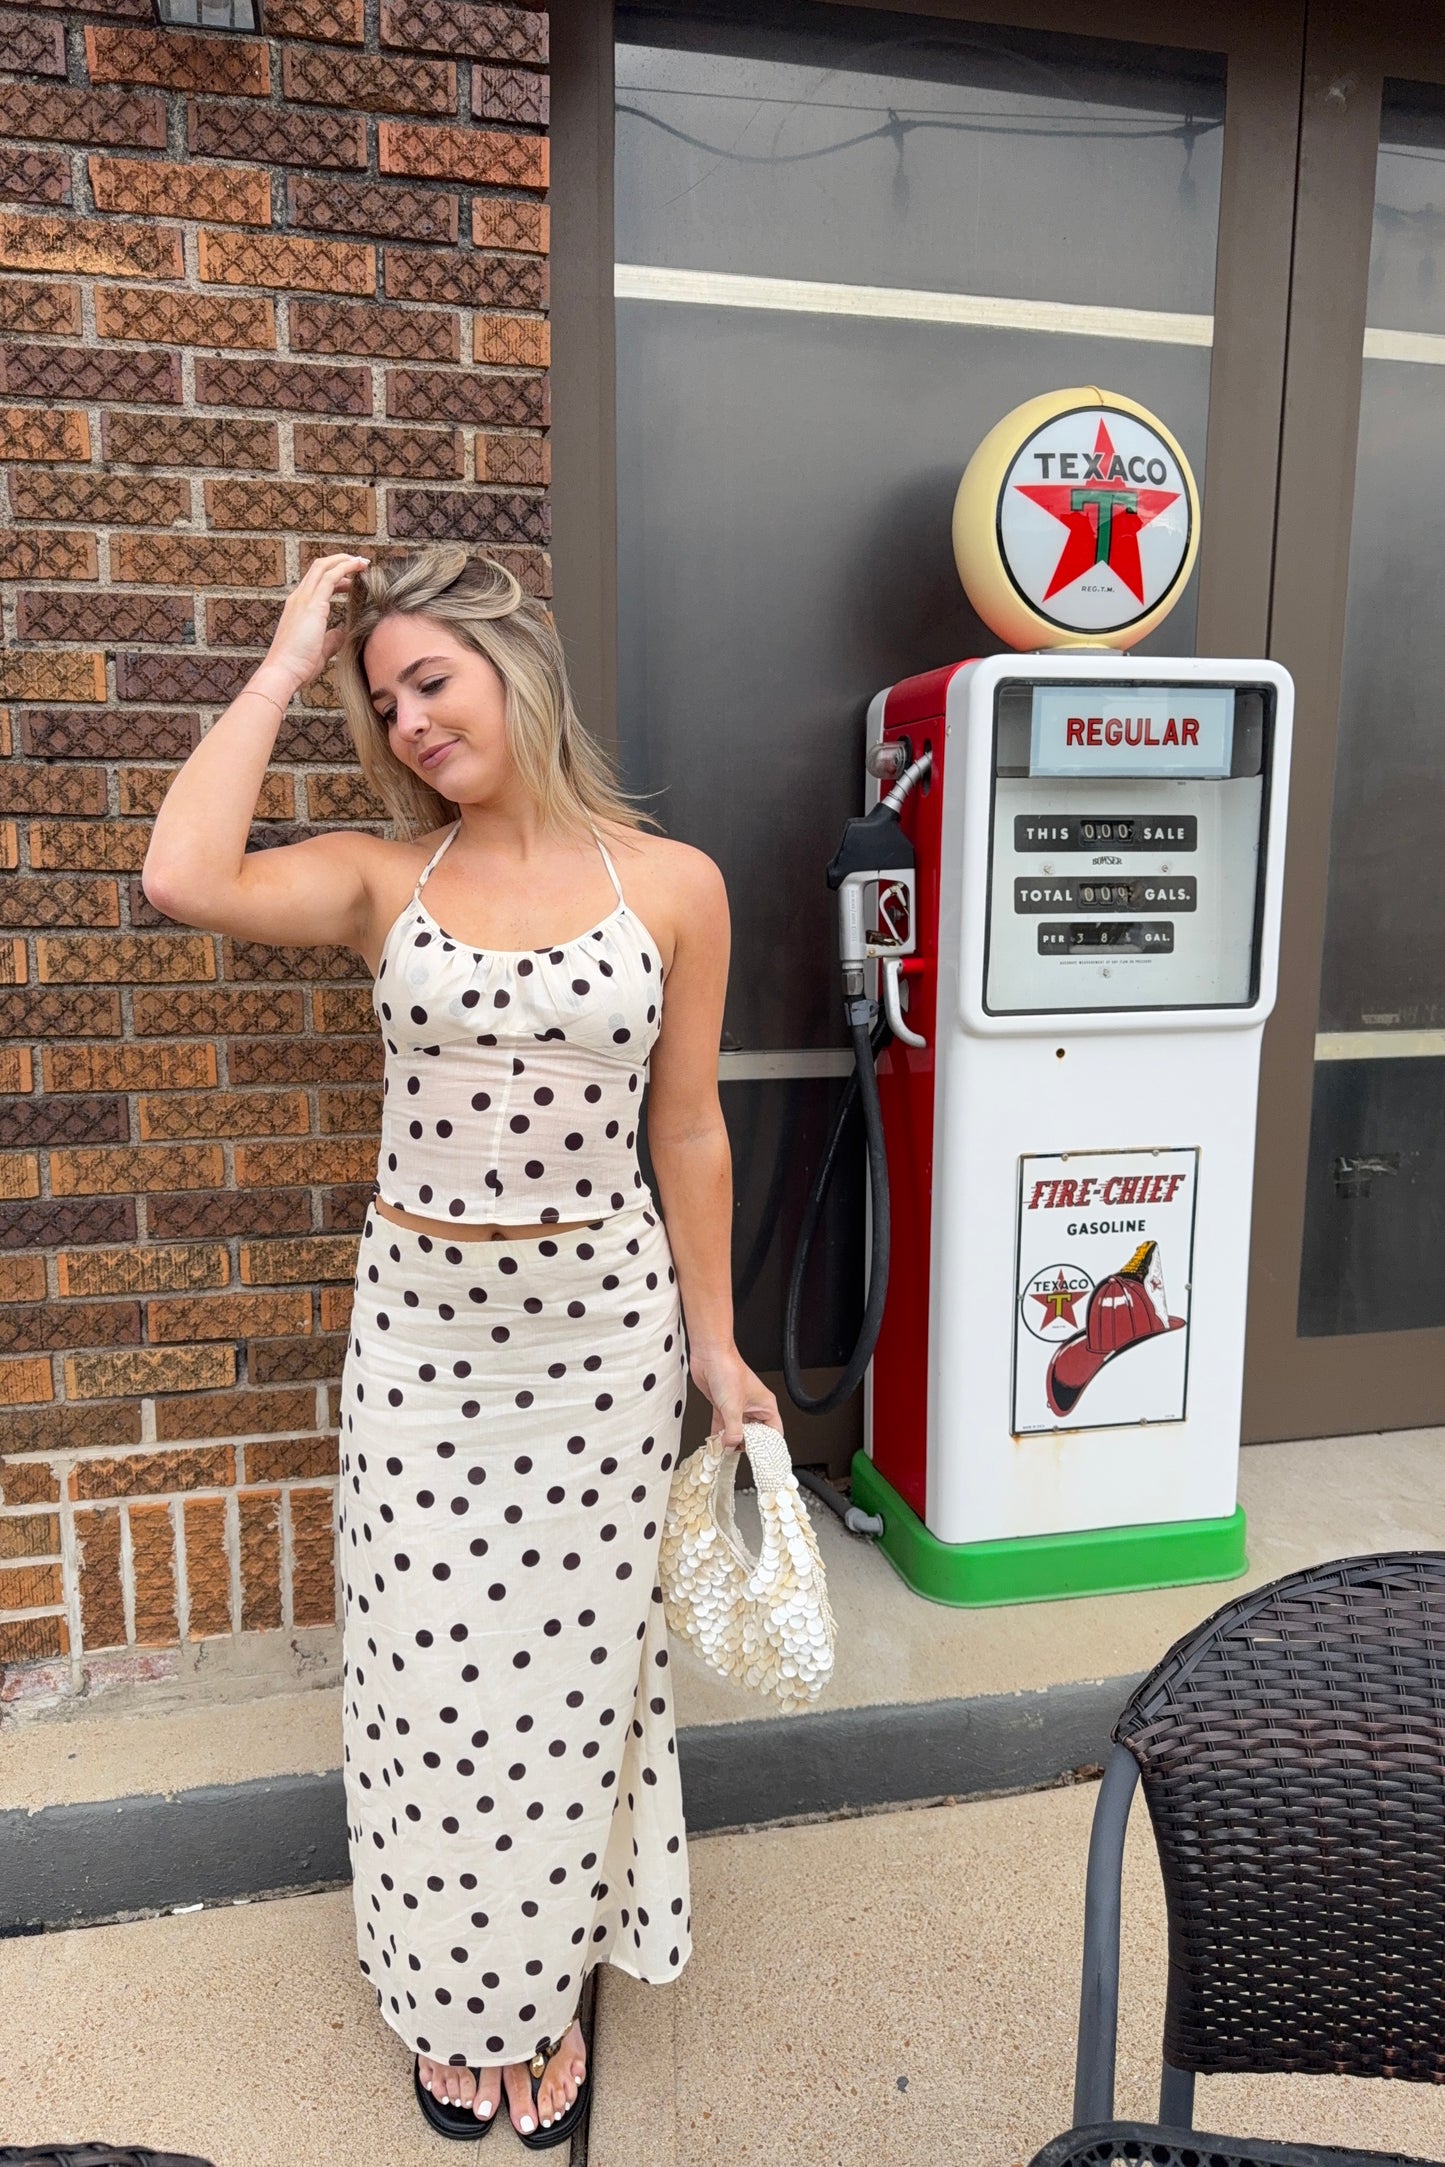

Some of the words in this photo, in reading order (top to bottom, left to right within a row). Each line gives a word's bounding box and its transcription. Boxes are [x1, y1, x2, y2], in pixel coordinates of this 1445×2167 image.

[1034, 452, 1167, 485] TEXACO
[1070, 488, 1138, 565] T
[1066, 718, 1200, 746] REGULAR
[1026, 828, 1069, 840] THIS
[1143, 828, 1185, 840] SALE
[1020, 889, 1073, 902] TOTAL
[1144, 888, 1191, 901] GALS.
[1042, 935, 1065, 943] PER
[1144, 933, 1170, 941] GAL.
[1028, 1174, 1186, 1209] FIRE-CHIEF
[1067, 1219, 1146, 1236] GASOLINE
[1033, 1278, 1089, 1292] TEXACO
[1046, 1293, 1073, 1317] T
